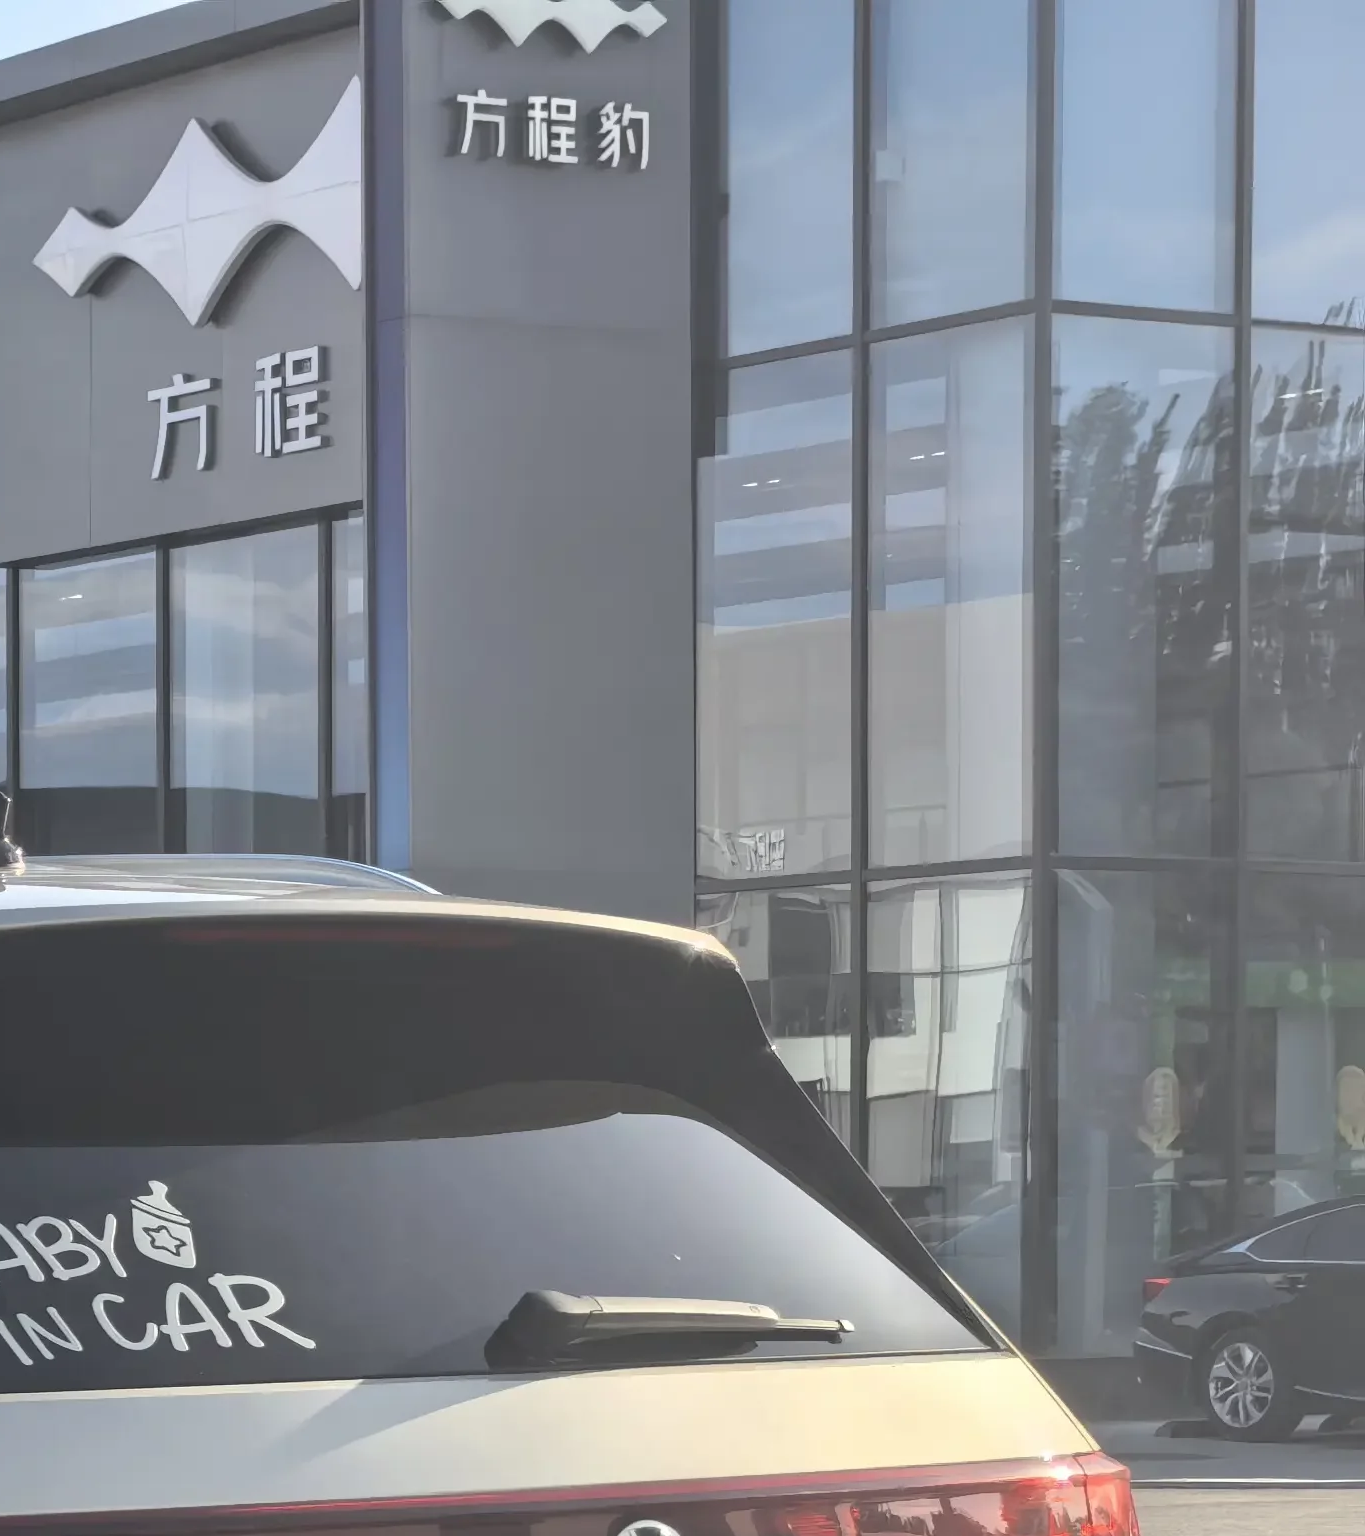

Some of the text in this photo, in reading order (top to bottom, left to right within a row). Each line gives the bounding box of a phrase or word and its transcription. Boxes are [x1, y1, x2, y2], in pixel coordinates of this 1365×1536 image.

[456, 89, 651, 170] 方程豹
[147, 345, 331, 480] 方程
[91, 1273, 316, 1352] CAR
